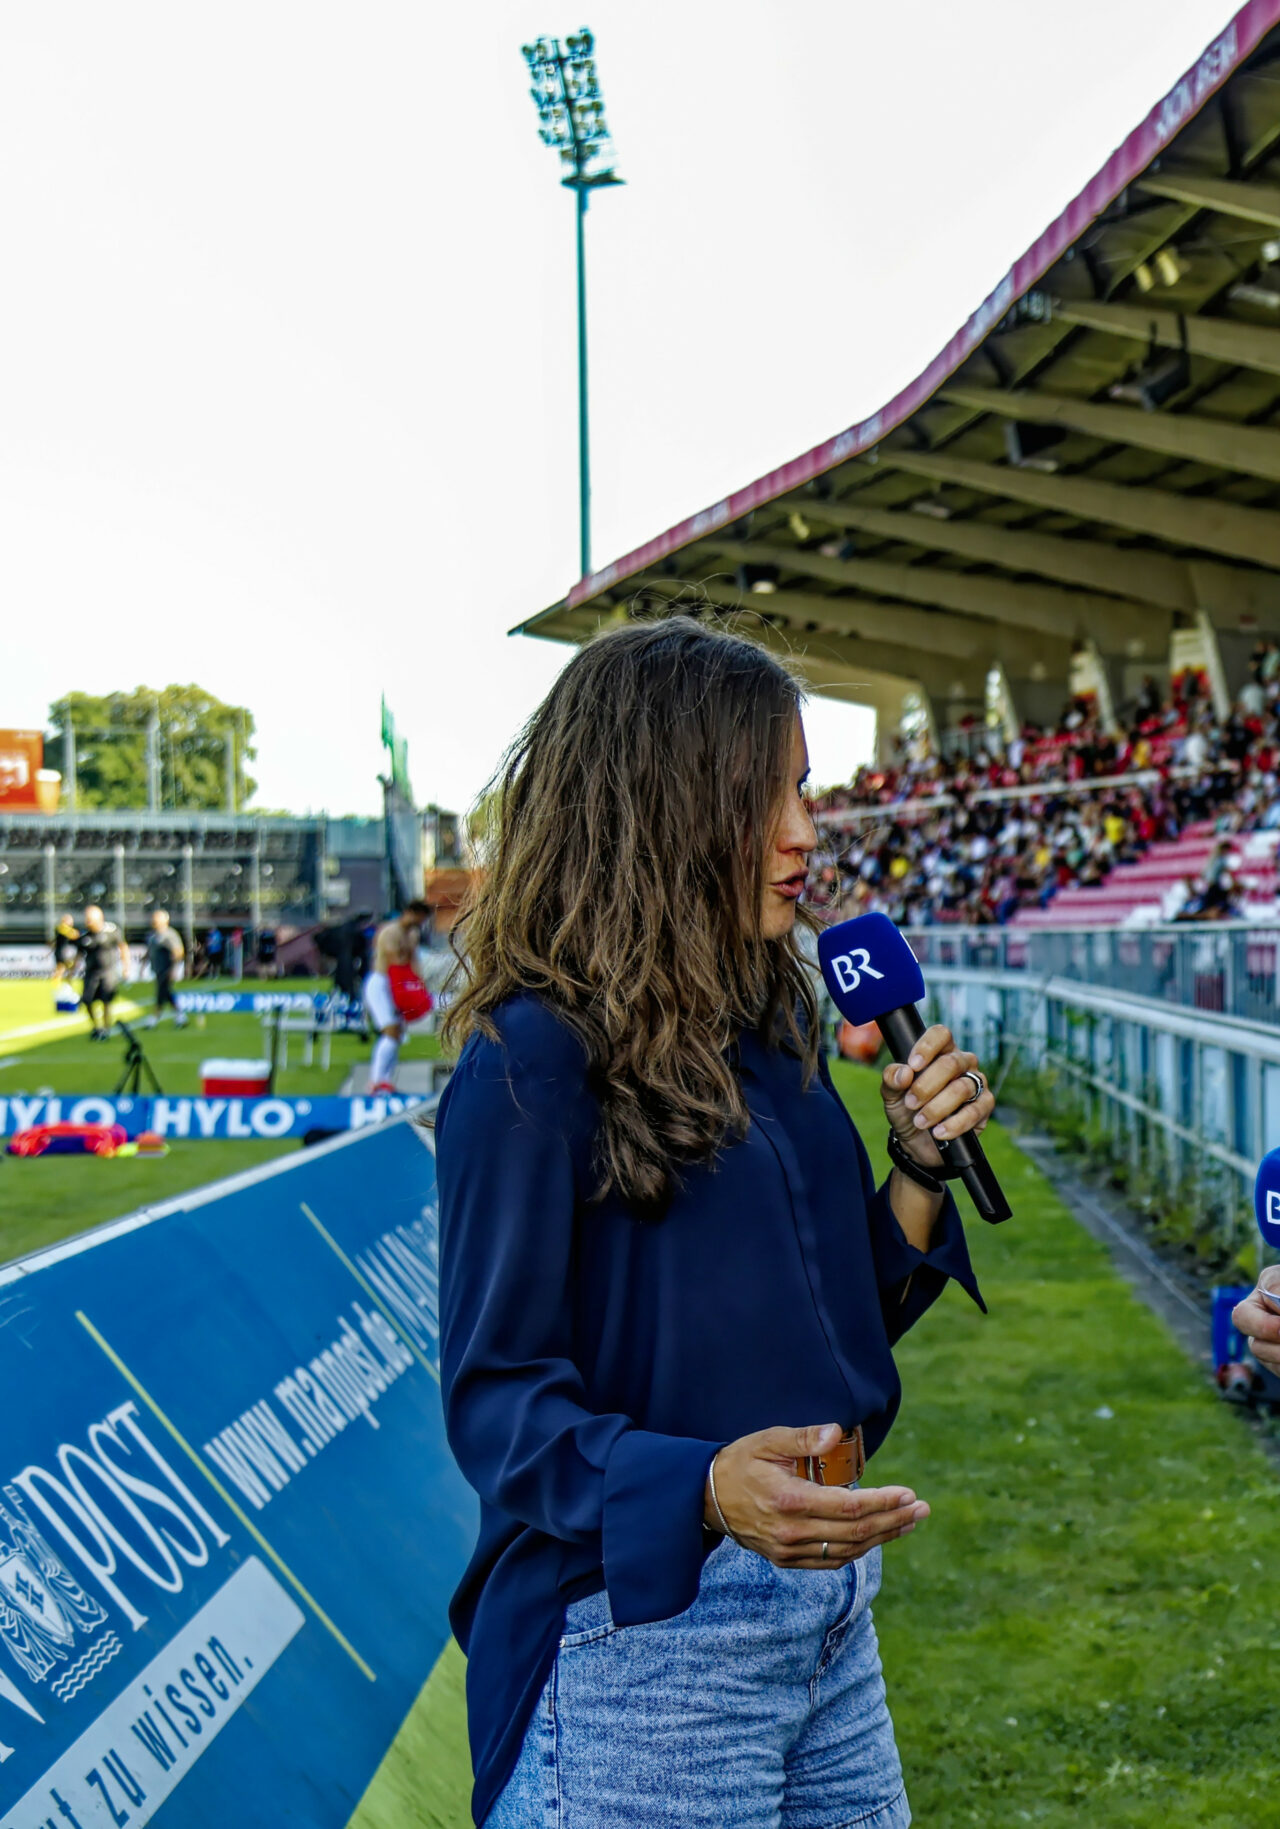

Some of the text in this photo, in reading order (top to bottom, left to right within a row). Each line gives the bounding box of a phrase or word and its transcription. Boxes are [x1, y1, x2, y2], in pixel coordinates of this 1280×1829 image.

[830, 948, 885, 994] BR
[11, 1402, 232, 1632] POST
[85, 1632, 253, 1829] zu wissen.
